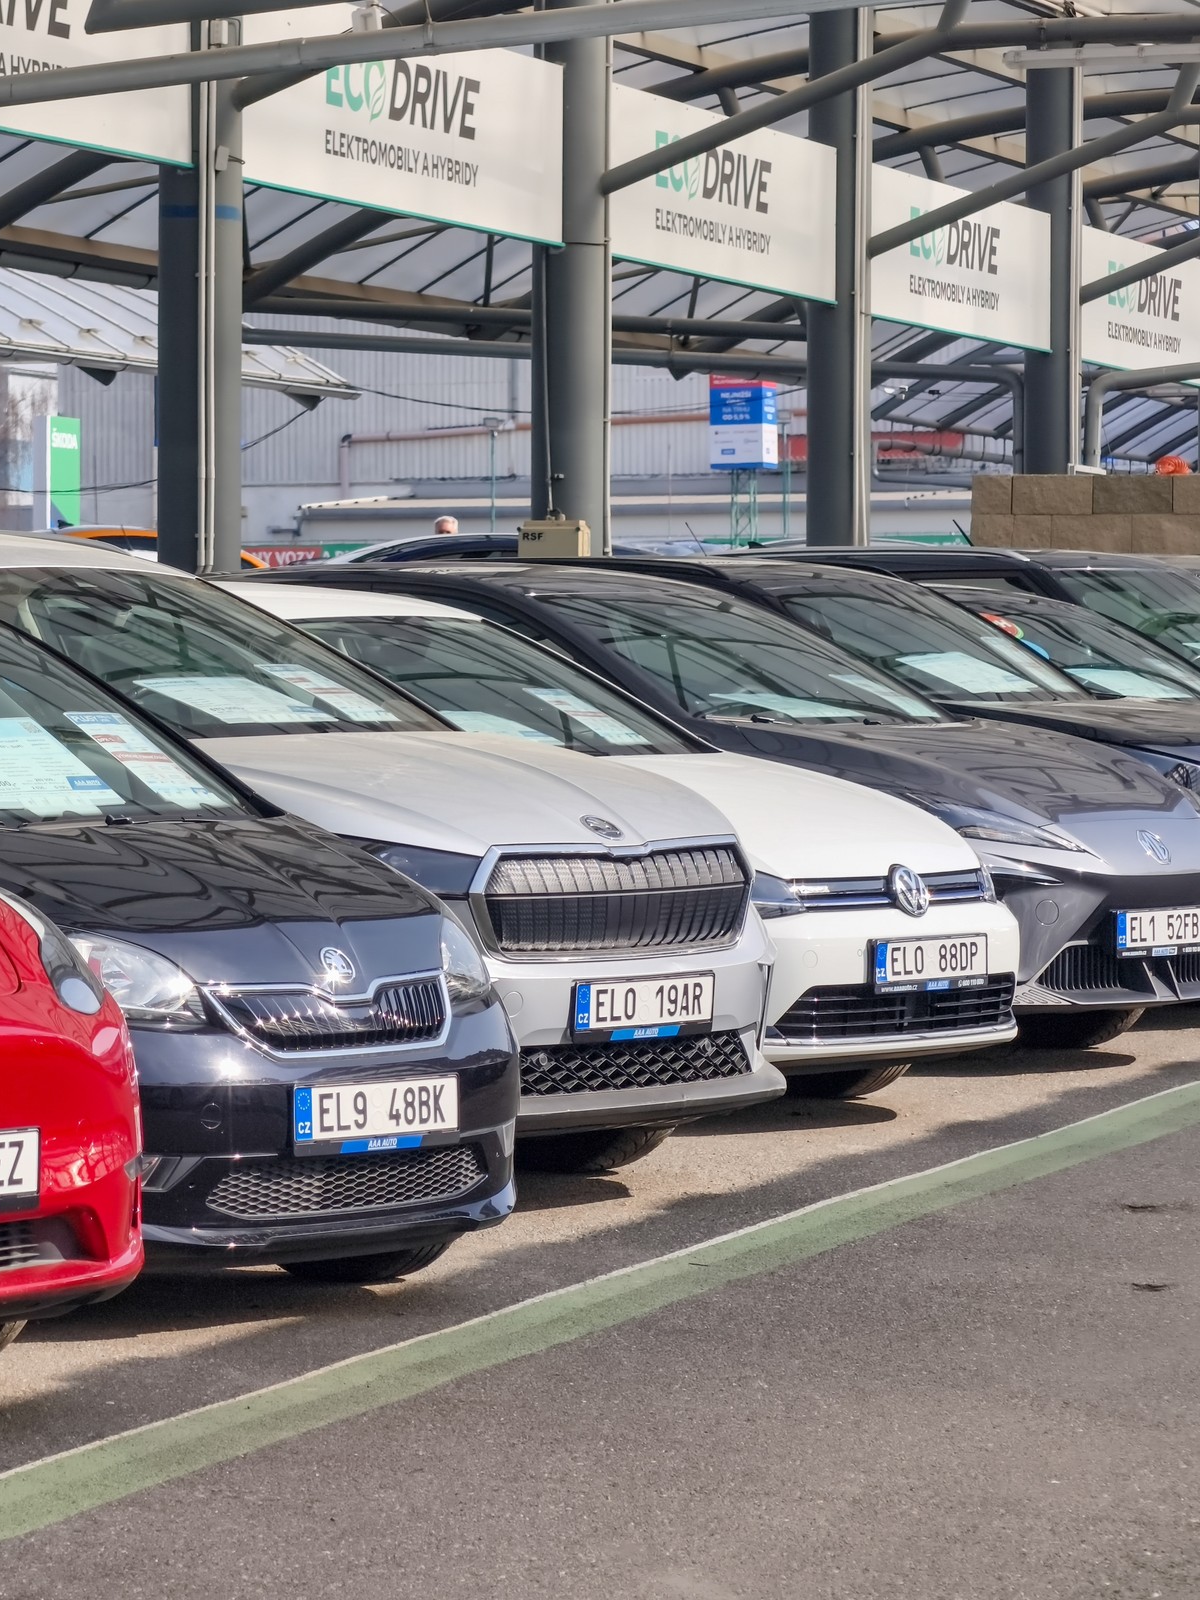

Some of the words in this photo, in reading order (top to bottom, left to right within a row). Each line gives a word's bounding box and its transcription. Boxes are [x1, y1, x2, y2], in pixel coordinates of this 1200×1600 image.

[325, 129, 420, 175] ELEKTROMOBILY
[422, 152, 430, 177] A
[431, 154, 479, 187] HYBRIDY
[656, 208, 727, 244] ELEKTROMOBILY
[728, 225, 735, 247] A
[735, 227, 771, 255] HYBRIDY
[909, 274, 966, 304] ELEKTROMOBILY
[966, 287, 972, 306] A
[972, 288, 1000, 311] HYBRIDY
[1107, 321, 1153, 348] ELEKTROMOBILY
[1158, 333, 1181, 354] HYBRIDY
[51, 427, 78, 450] ŠKODA
[522, 532, 543, 541] RSF
[1118, 935, 1126, 944] CZ
[1130, 915, 1155, 943] EL1
[1167, 912, 1199, 940] 52FB
[876, 967, 886, 977] CZ
[939, 941, 978, 972] 88DP
[578, 1013, 589, 1024] CZ
[655, 982, 703, 1018] 19AR
[633, 1029, 645, 1037] AAA
[645, 1027, 659, 1036] AUTO
[298, 1121, 311, 1134] CZ
[319, 1090, 367, 1133] EL9
[388, 1084, 446, 1127] 48BK
[368, 1139, 382, 1149] AAA
[382, 1137, 398, 1148] AUTO
